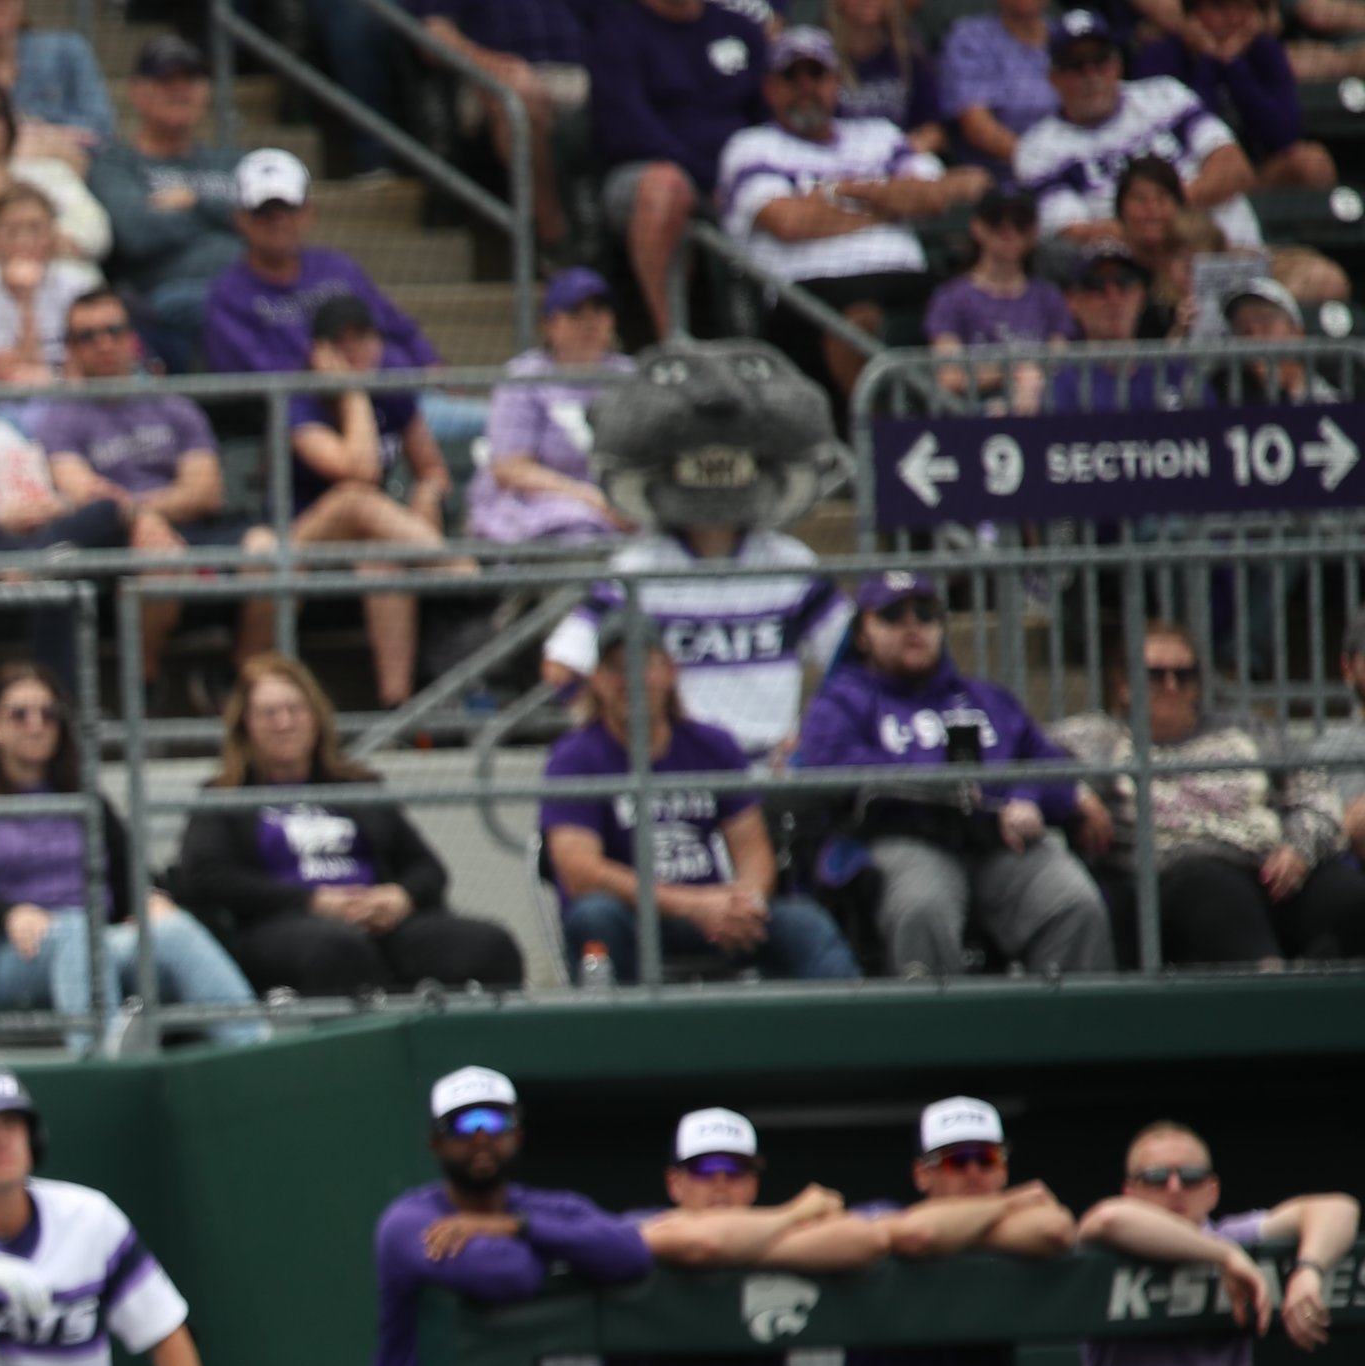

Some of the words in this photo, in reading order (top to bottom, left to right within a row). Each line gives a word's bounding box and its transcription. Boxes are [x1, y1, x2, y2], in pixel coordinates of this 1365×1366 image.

[981, 433, 1024, 495] 9
[1046, 438, 1211, 483] SECTION
[1225, 423, 1295, 486] 10
[663, 616, 785, 663] CATS
